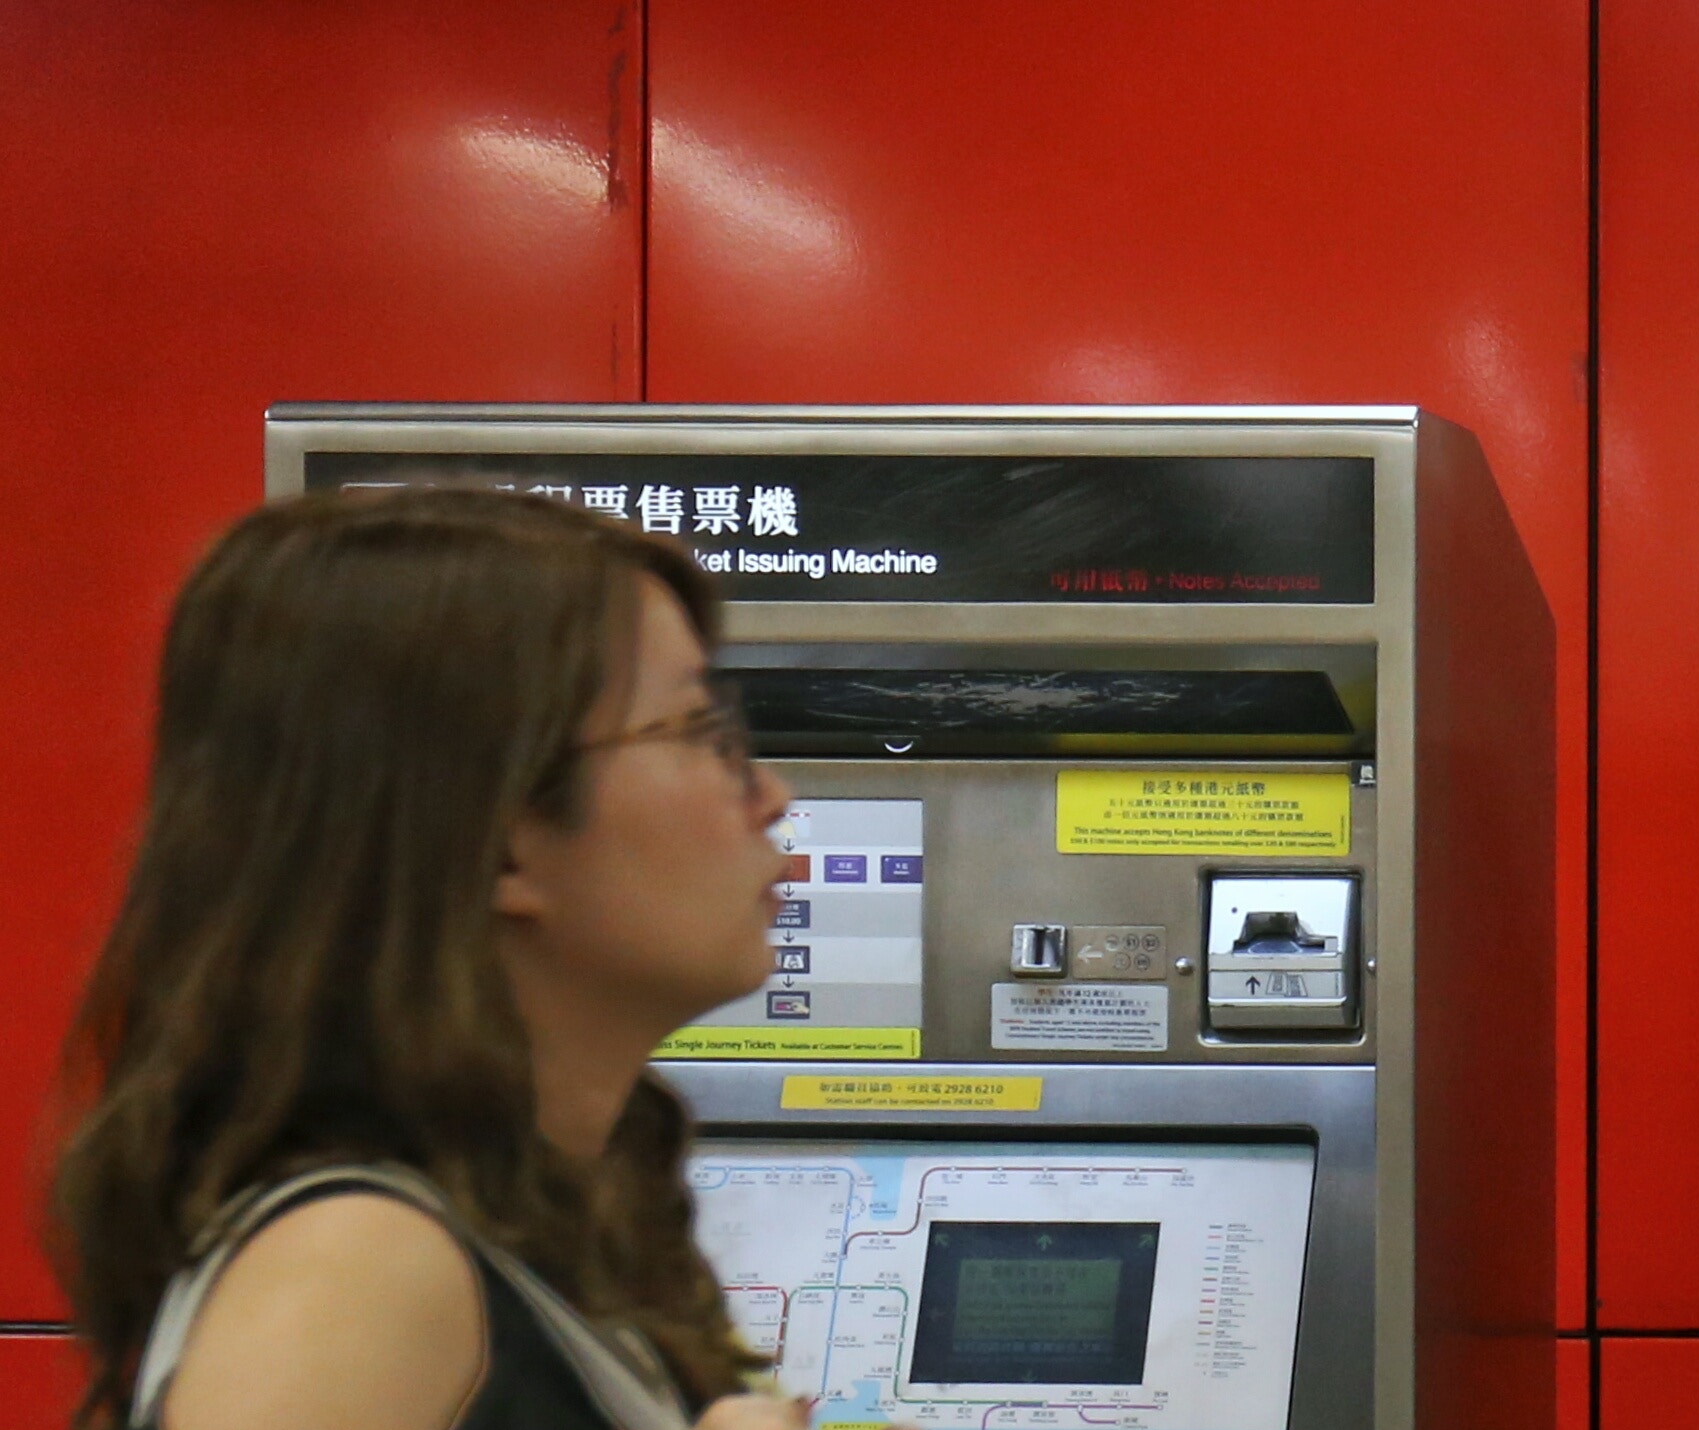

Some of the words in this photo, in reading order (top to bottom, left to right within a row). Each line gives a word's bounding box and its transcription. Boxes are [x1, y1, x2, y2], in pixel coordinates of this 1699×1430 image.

[496, 484, 799, 537] 票售票機
[694, 549, 731, 573] ket
[738, 549, 826, 579] Issuing
[832, 549, 937, 573] Machine
[1169, 573, 1224, 590] Notes
[1229, 573, 1321, 592] Accepted
[1143, 780, 1266, 796] 接受多種港元紙幣
[1073, 827, 1090, 836] This
[1090, 828, 1122, 836] machine
[1123, 828, 1152, 839] accepts
[1151, 829, 1173, 839] Hong
[1173, 829, 1194, 839] Kong
[1194, 829, 1234, 838] banknotes
[1234, 829, 1243, 838] of
[1243, 829, 1276, 838] different
[1276, 830, 1333, 839] denominations
[674, 1039, 703, 1052] Single
[705, 1039, 742, 1052] Journey
[743, 1040, 776, 1051] Tickets
[944, 1083, 973, 1094] 2928
[975, 1083, 1004, 1095] 6210
